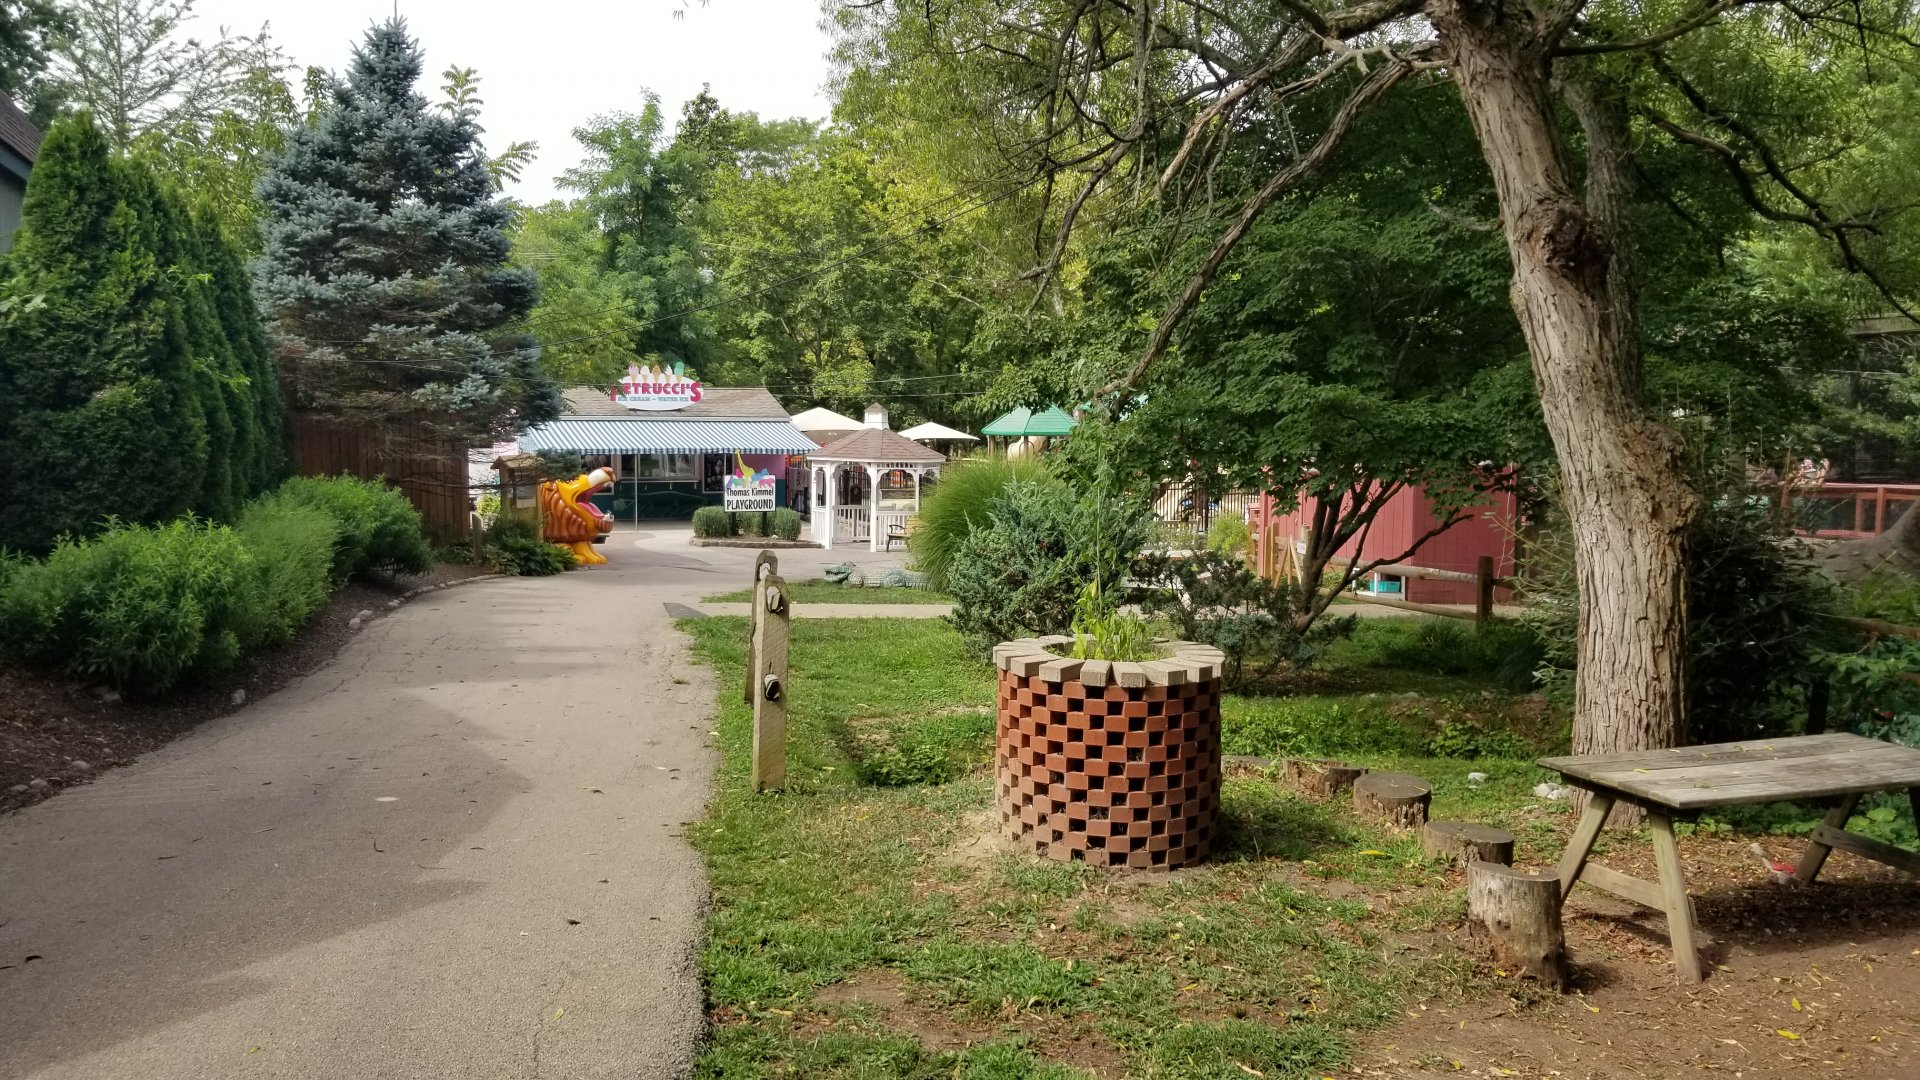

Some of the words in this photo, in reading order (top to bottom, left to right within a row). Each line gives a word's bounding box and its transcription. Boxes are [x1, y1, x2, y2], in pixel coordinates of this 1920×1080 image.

[726, 488, 750, 496] Thomas
[751, 487, 774, 496] Kimmel
[726, 499, 774, 510] PLAYGROUND
